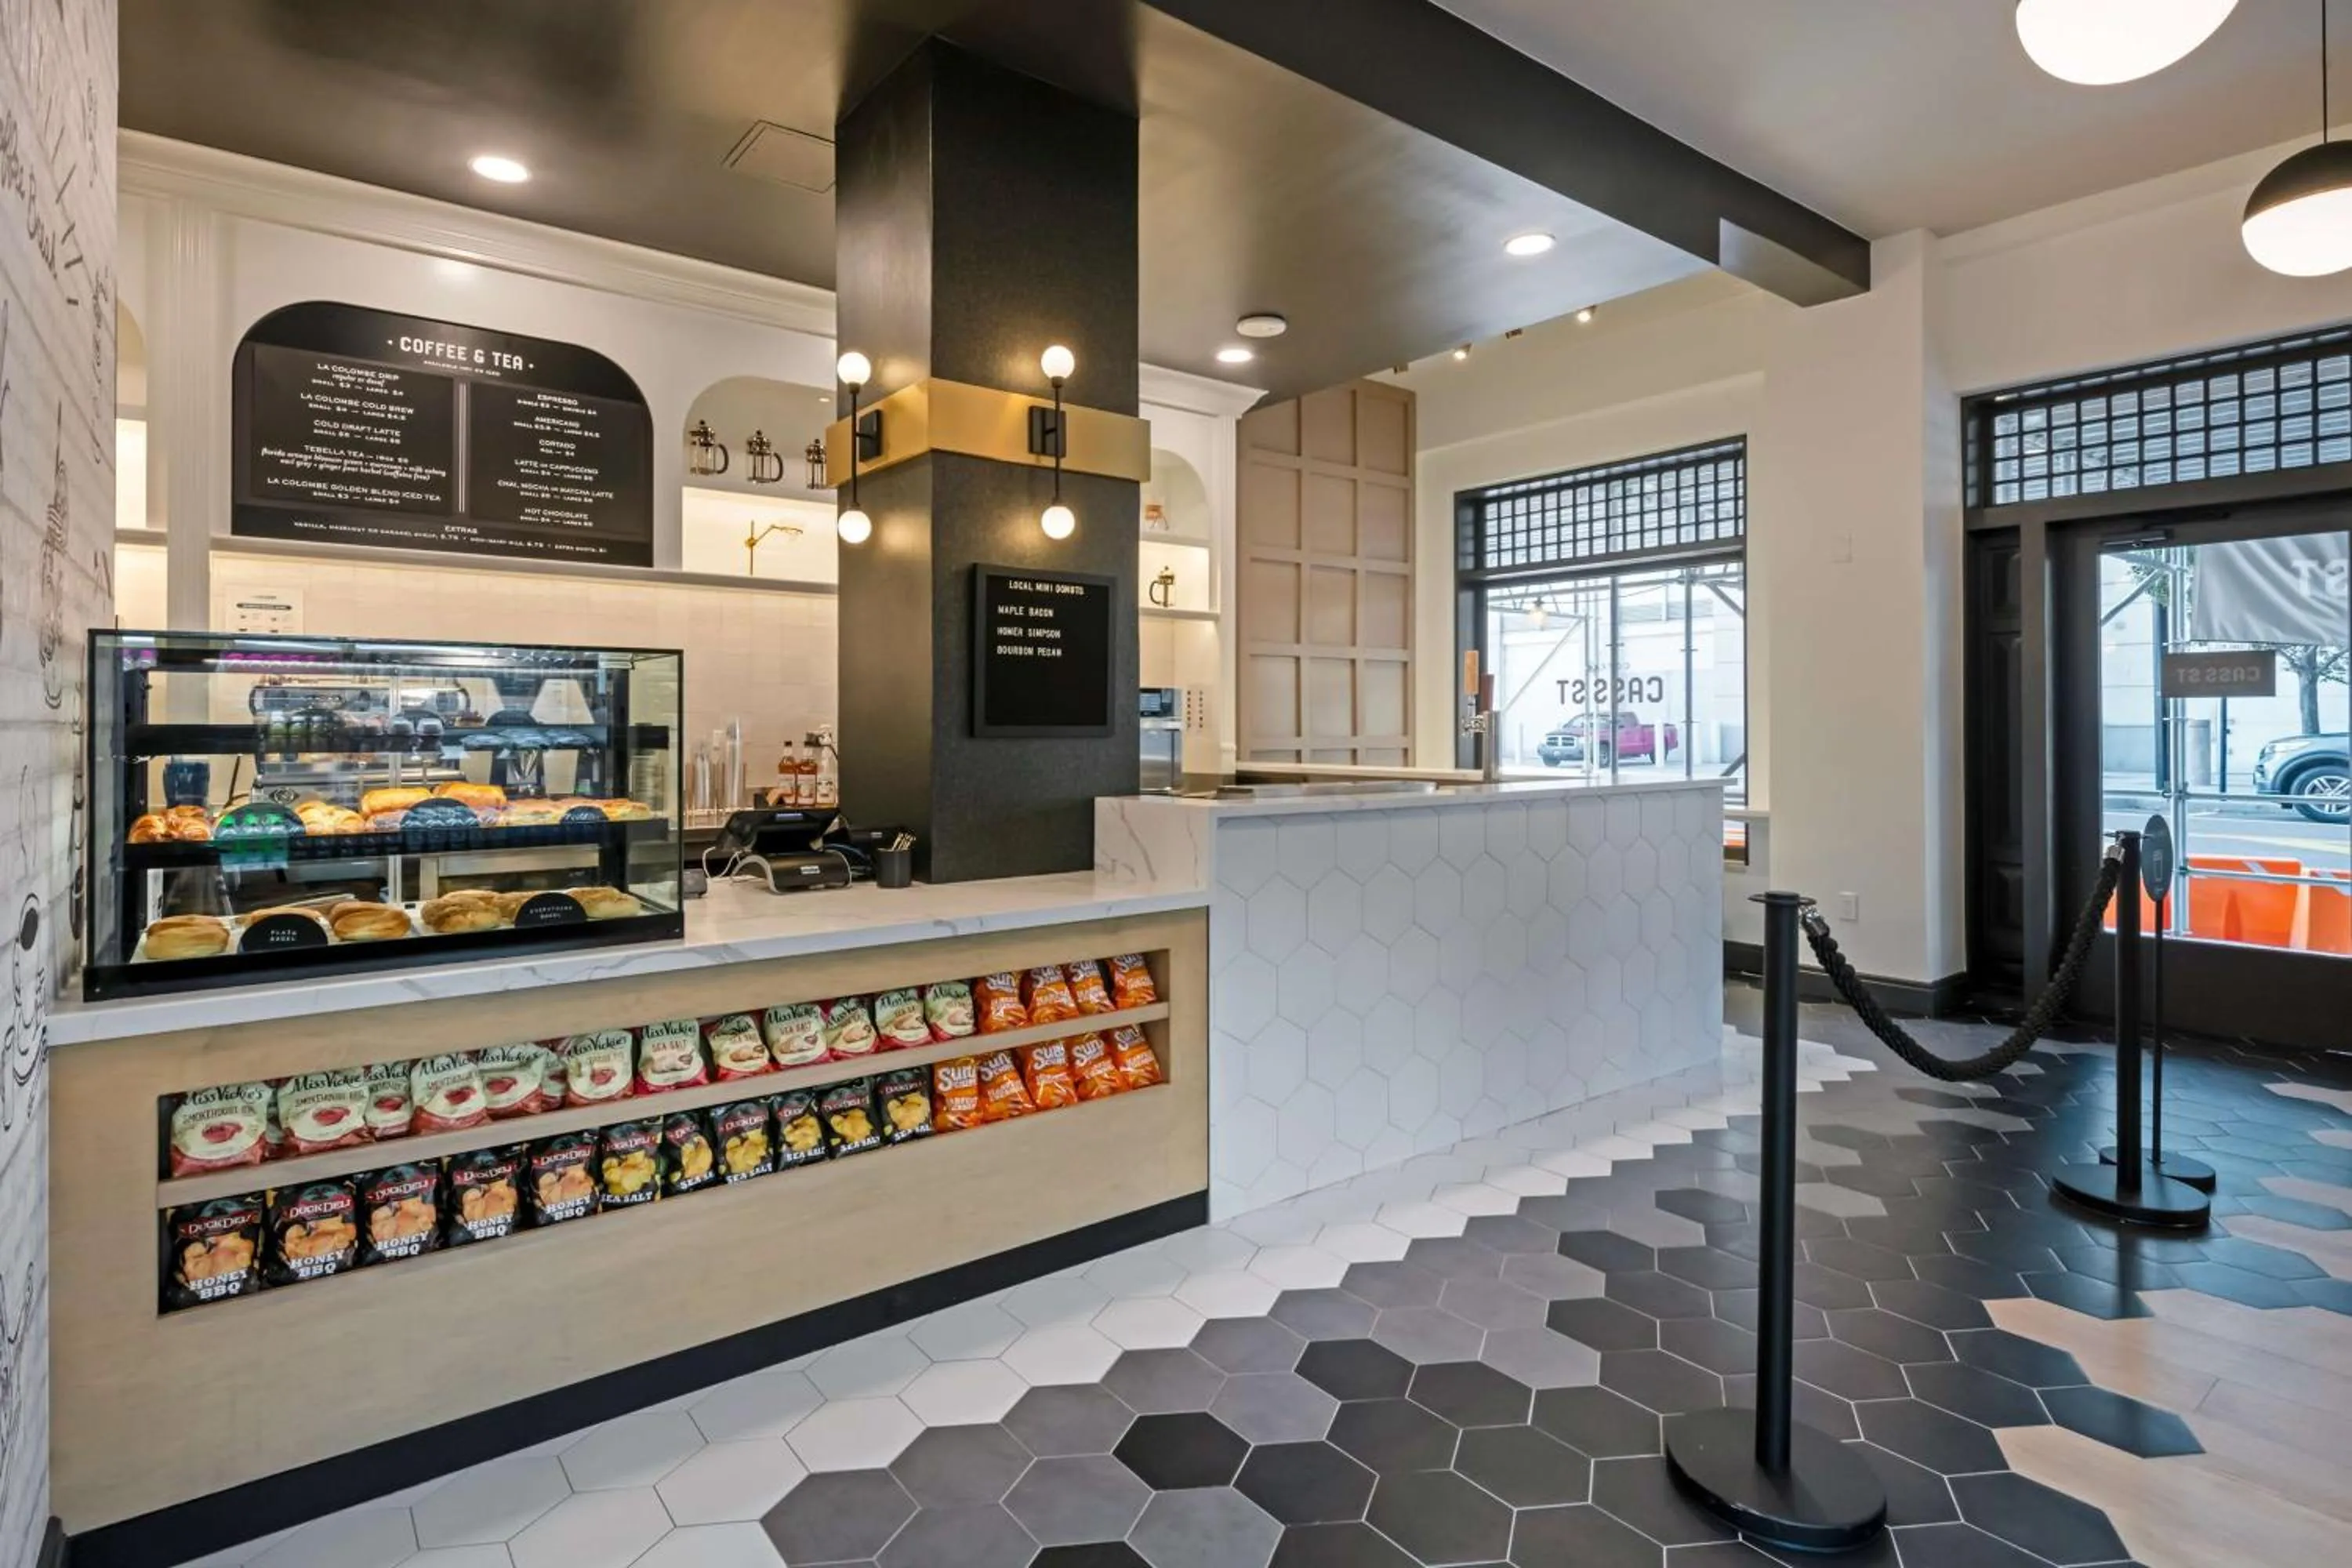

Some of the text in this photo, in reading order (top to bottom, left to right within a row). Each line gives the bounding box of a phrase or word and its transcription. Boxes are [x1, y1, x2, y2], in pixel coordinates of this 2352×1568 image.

[399, 336, 523, 371] COFFEE & TEA
[332, 365, 376, 378] COLOMBE
[379, 372, 400, 381] DRIP
[314, 394, 361, 407] COLOMBE
[361, 401, 387, 411] COLD
[388, 405, 415, 415] BREW
[537, 394, 579, 406] ESPRESSO
[314, 419, 401, 437] COLD DRAFT LATTE
[535, 416, 581, 429] AMERICANO
[303, 445, 365, 459] TEBELLA TEA
[539, 439, 576, 450] CORTADO
[514, 459, 539, 469] LATTE
[550, 463, 599, 475] CAPPUCCINO
[267, 477, 441, 503] LA COLOMBE GOLDEN BLEND ICED TEA
[521, 483, 550, 492] MOCHA
[560, 486, 590, 496] MATCHA
[591, 490, 615, 500] LATTE
[543, 509, 590, 521] CHOCOLATE
[445, 524, 479, 535] EXTRAS
[1009, 579, 1084, 596] LOCAL MINI DONUTS
[997, 604, 1054, 618] MAPLE BACON
[996, 626, 1061, 639] HOMER SIMPSON
[996, 645, 1062, 658] BOURBON PECAN
[652, 1039, 688, 1052] SEA SALT
[1114, 1028, 1141, 1051] Sun
[1033, 1043, 1065, 1070] Sun
[1072, 1040, 1105, 1067] Sun
[419, 1060, 451, 1077] Miss
[980, 1051, 1011, 1082] Sun
[292, 1075, 325, 1094] Miss
[938, 1065, 976, 1091] Sun
[840, 1141, 860, 1152] SEA
[541, 1152, 570, 1166] DUCK
[546, 1195, 591, 1214] HONEY
[624, 1191, 653, 1203] SALT
[290, 1198, 352, 1219] DUCK DELI
[554, 1207, 586, 1221] BBQ
[188, 1220, 223, 1235] DUCK
[467, 1213, 514, 1231] HONEY
[377, 1231, 429, 1250] HONEY
[475, 1225, 507, 1240] BBQ
[386, 1243, 420, 1258] BBQ
[290, 1250, 346, 1270] HONEY
[298, 1262, 337, 1279] BBQ
[189, 1269, 249, 1291] HONEY
[199, 1282, 241, 1300] BBQ
